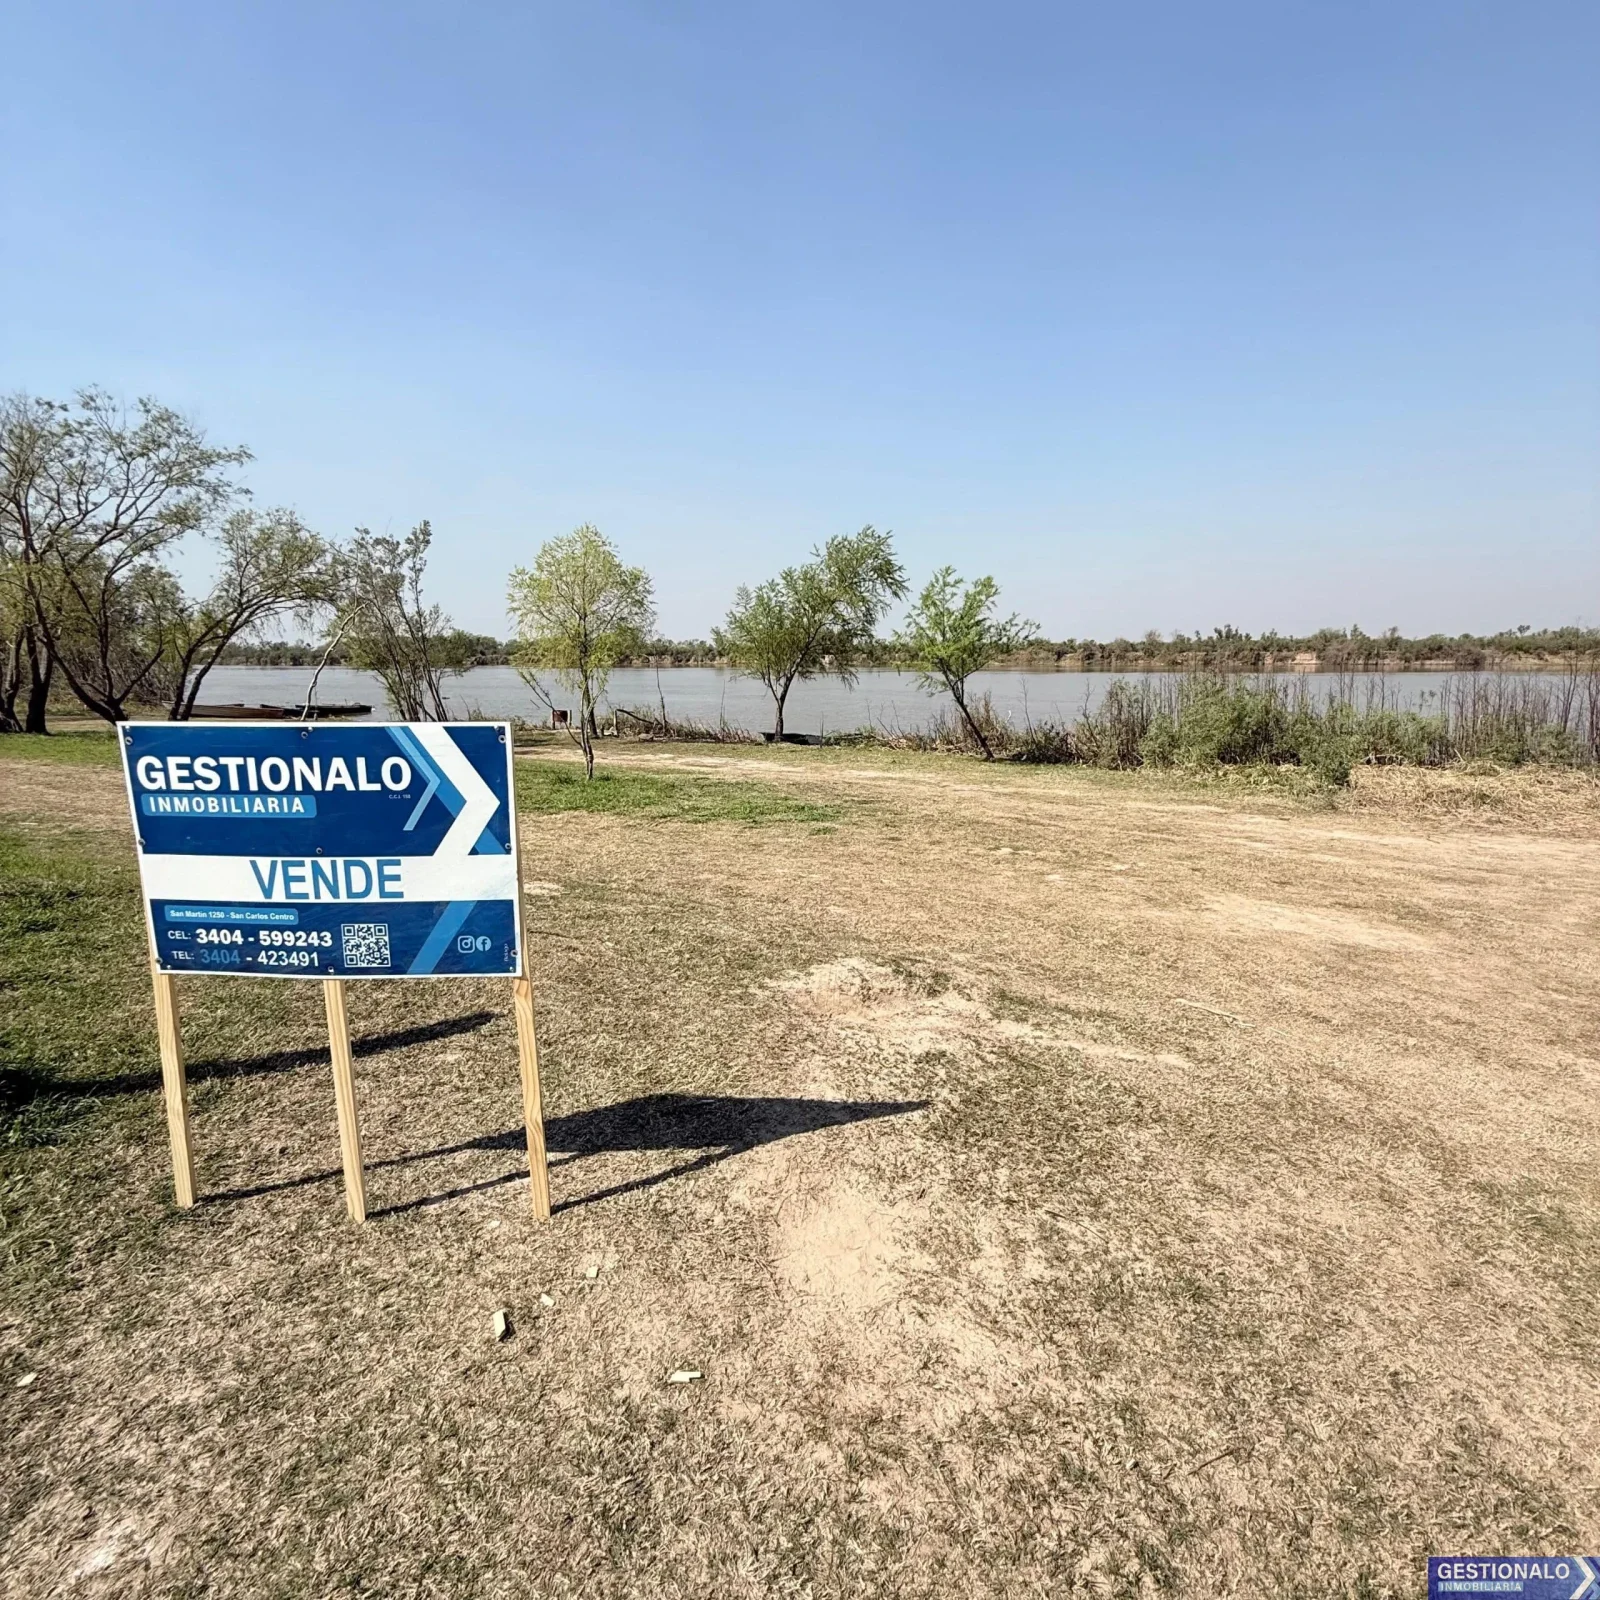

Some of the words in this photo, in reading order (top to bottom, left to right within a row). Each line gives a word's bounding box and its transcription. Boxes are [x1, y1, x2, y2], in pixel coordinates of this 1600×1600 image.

[136, 755, 412, 793] GESTIONALO
[149, 796, 306, 814] INMOBILIARIA
[249, 859, 404, 900] VENDE
[208, 911, 225, 919] 1250
[245, 912, 268, 920] Carlos
[269, 912, 294, 920] Centro
[167, 930, 191, 940] CEL:
[195, 929, 244, 945] 3404
[258, 930, 333, 947] 599243
[171, 950, 195, 960] TEL:
[200, 949, 241, 964] 3404
[257, 950, 319, 967] 423491
